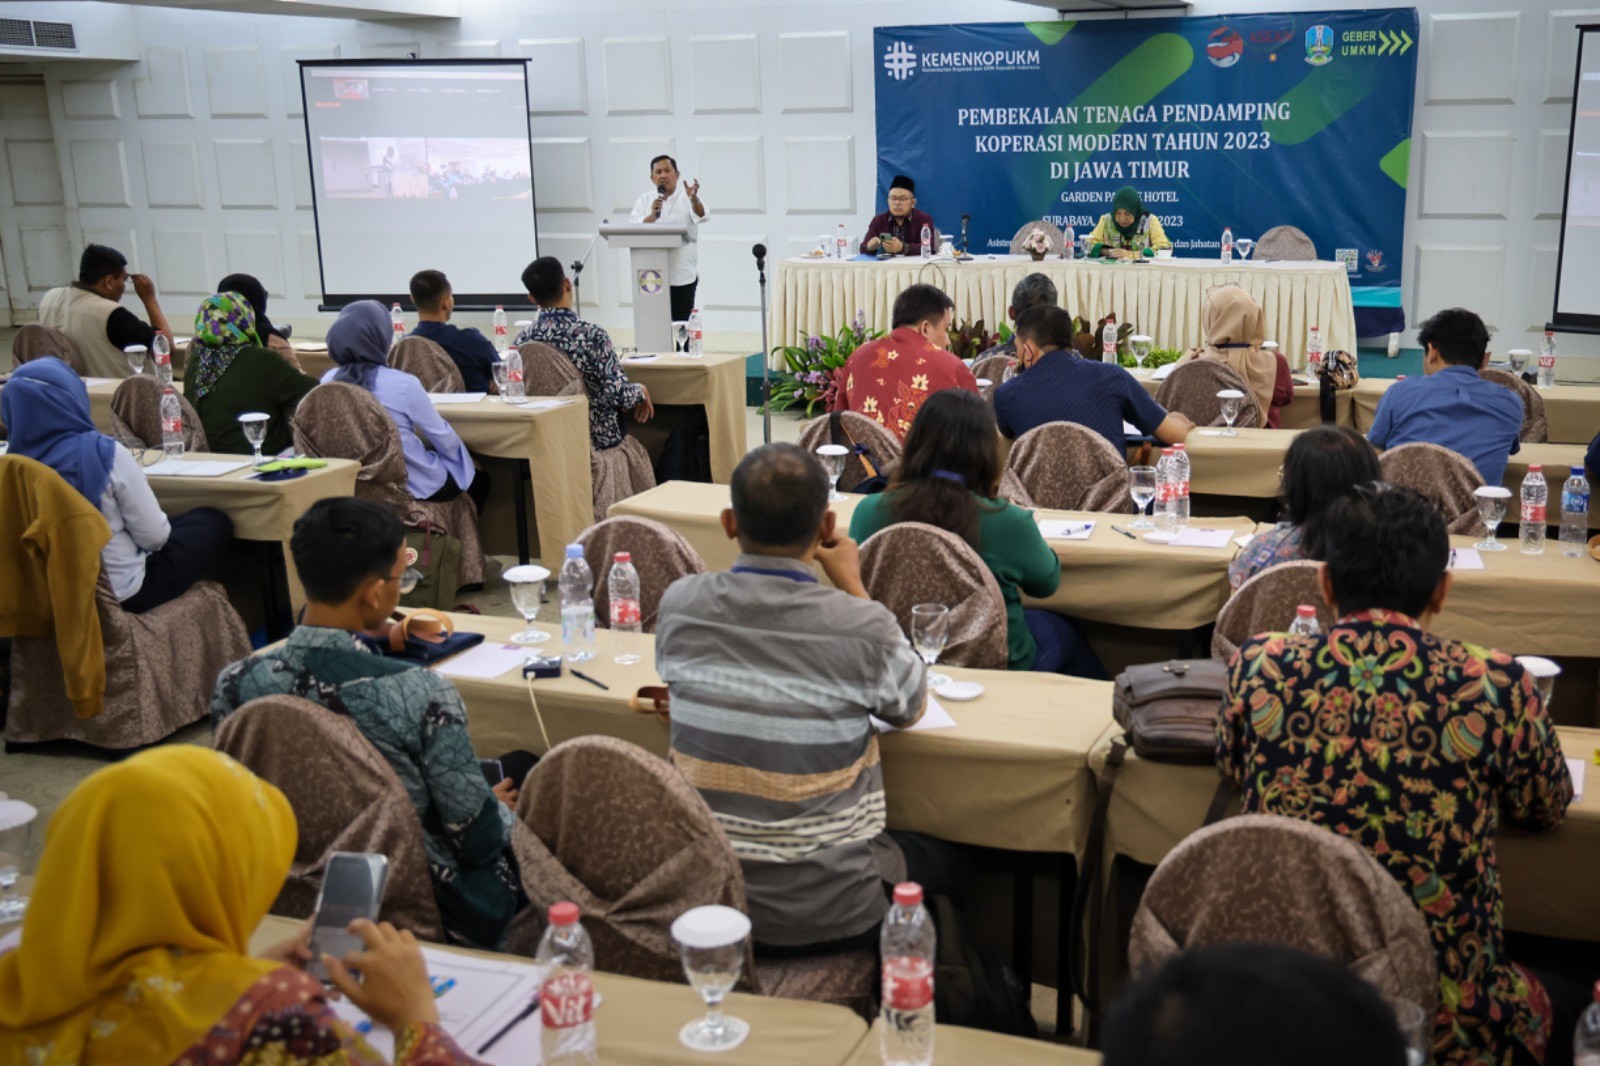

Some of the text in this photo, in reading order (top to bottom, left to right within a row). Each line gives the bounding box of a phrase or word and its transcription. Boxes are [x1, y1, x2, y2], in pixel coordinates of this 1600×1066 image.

[1341, 30, 1377, 42] GEBER
[1341, 45, 1376, 56] UMKM
[921, 50, 1040, 67] KEMENKOPUKM
[957, 102, 1291, 126] PEMBEKALAN TENAGA PENDAMPING
[975, 131, 1271, 153] KOPERASI MODERN TAHUN 2023
[1050, 160, 1191, 183] DI JAWA TIMUR
[1061, 191, 1103, 203] GARDEN
[1144, 191, 1179, 203] HOTEL
[1158, 215, 1184, 227] 2023
[1174, 239, 1190, 248] dan
[1190, 239, 1220, 250] Jabatan
[543, 993, 586, 1025] Vit
